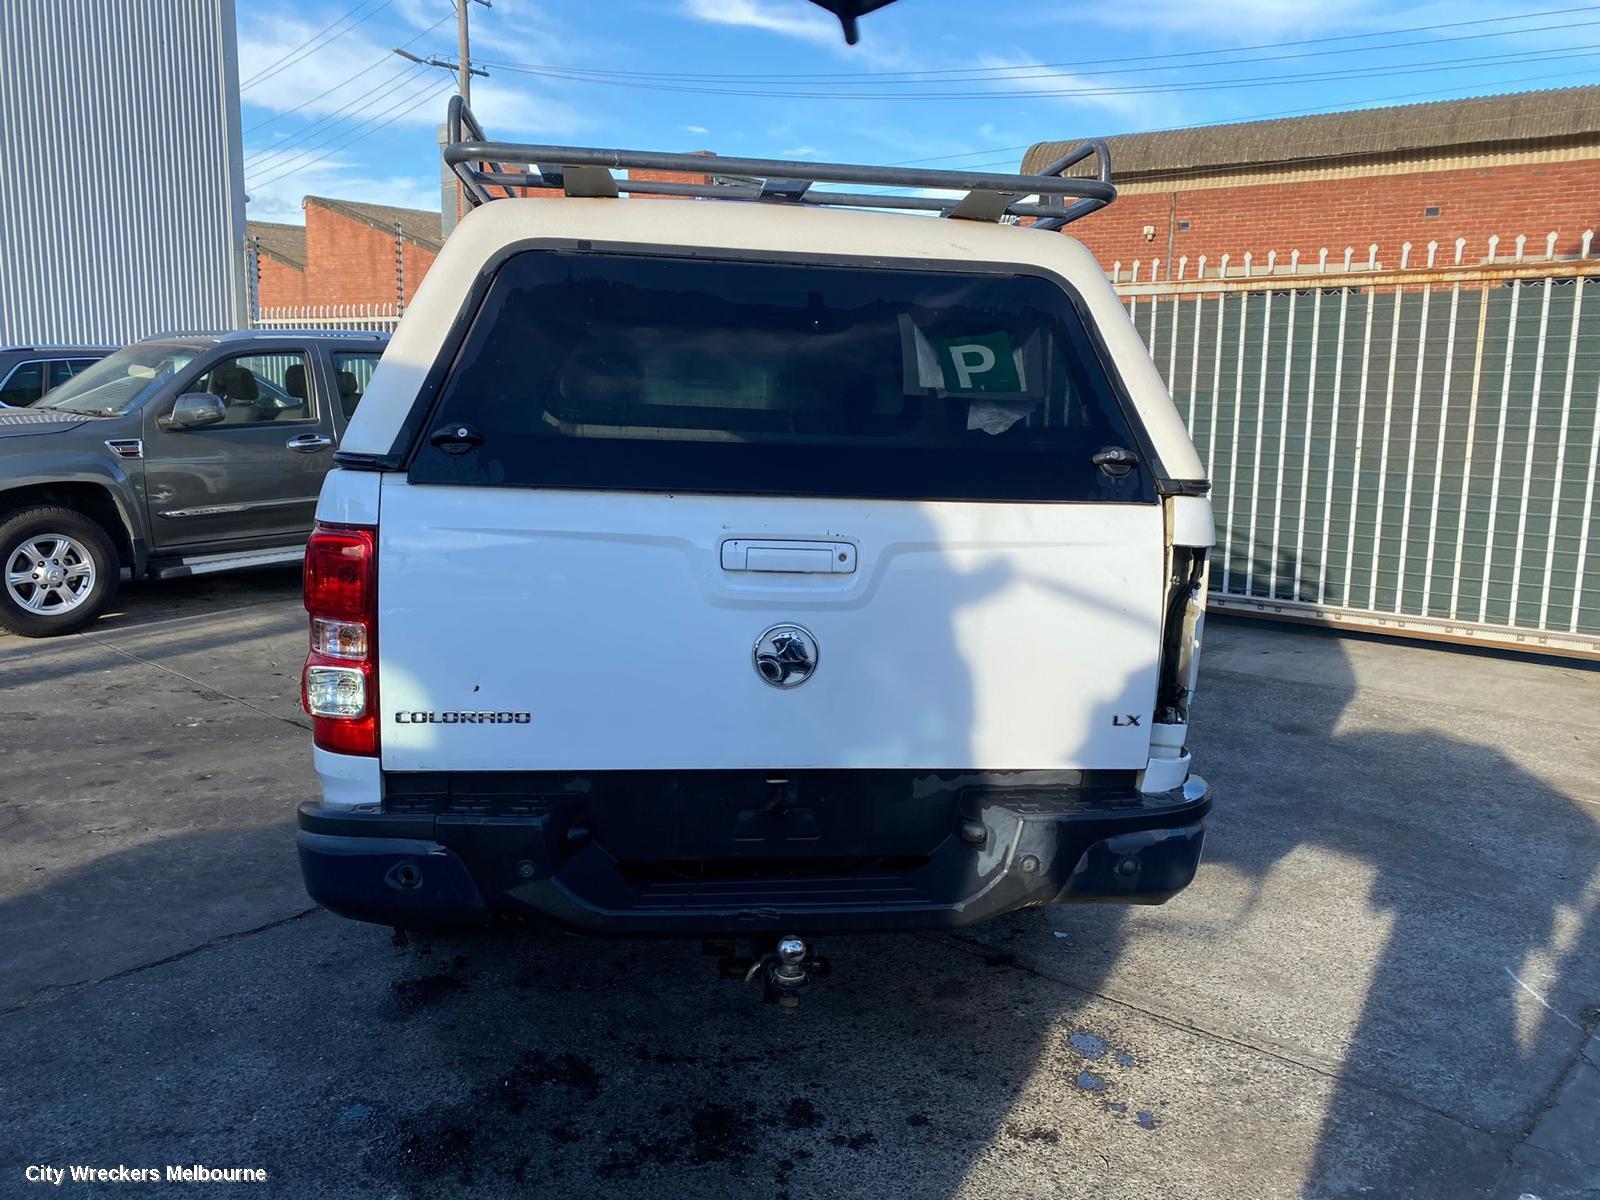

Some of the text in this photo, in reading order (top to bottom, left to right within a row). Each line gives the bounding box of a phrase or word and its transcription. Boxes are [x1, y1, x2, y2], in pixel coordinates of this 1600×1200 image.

[949, 344, 996, 389] P
[395, 711, 531, 724] COLORADO
[1112, 714, 1141, 727] LX
